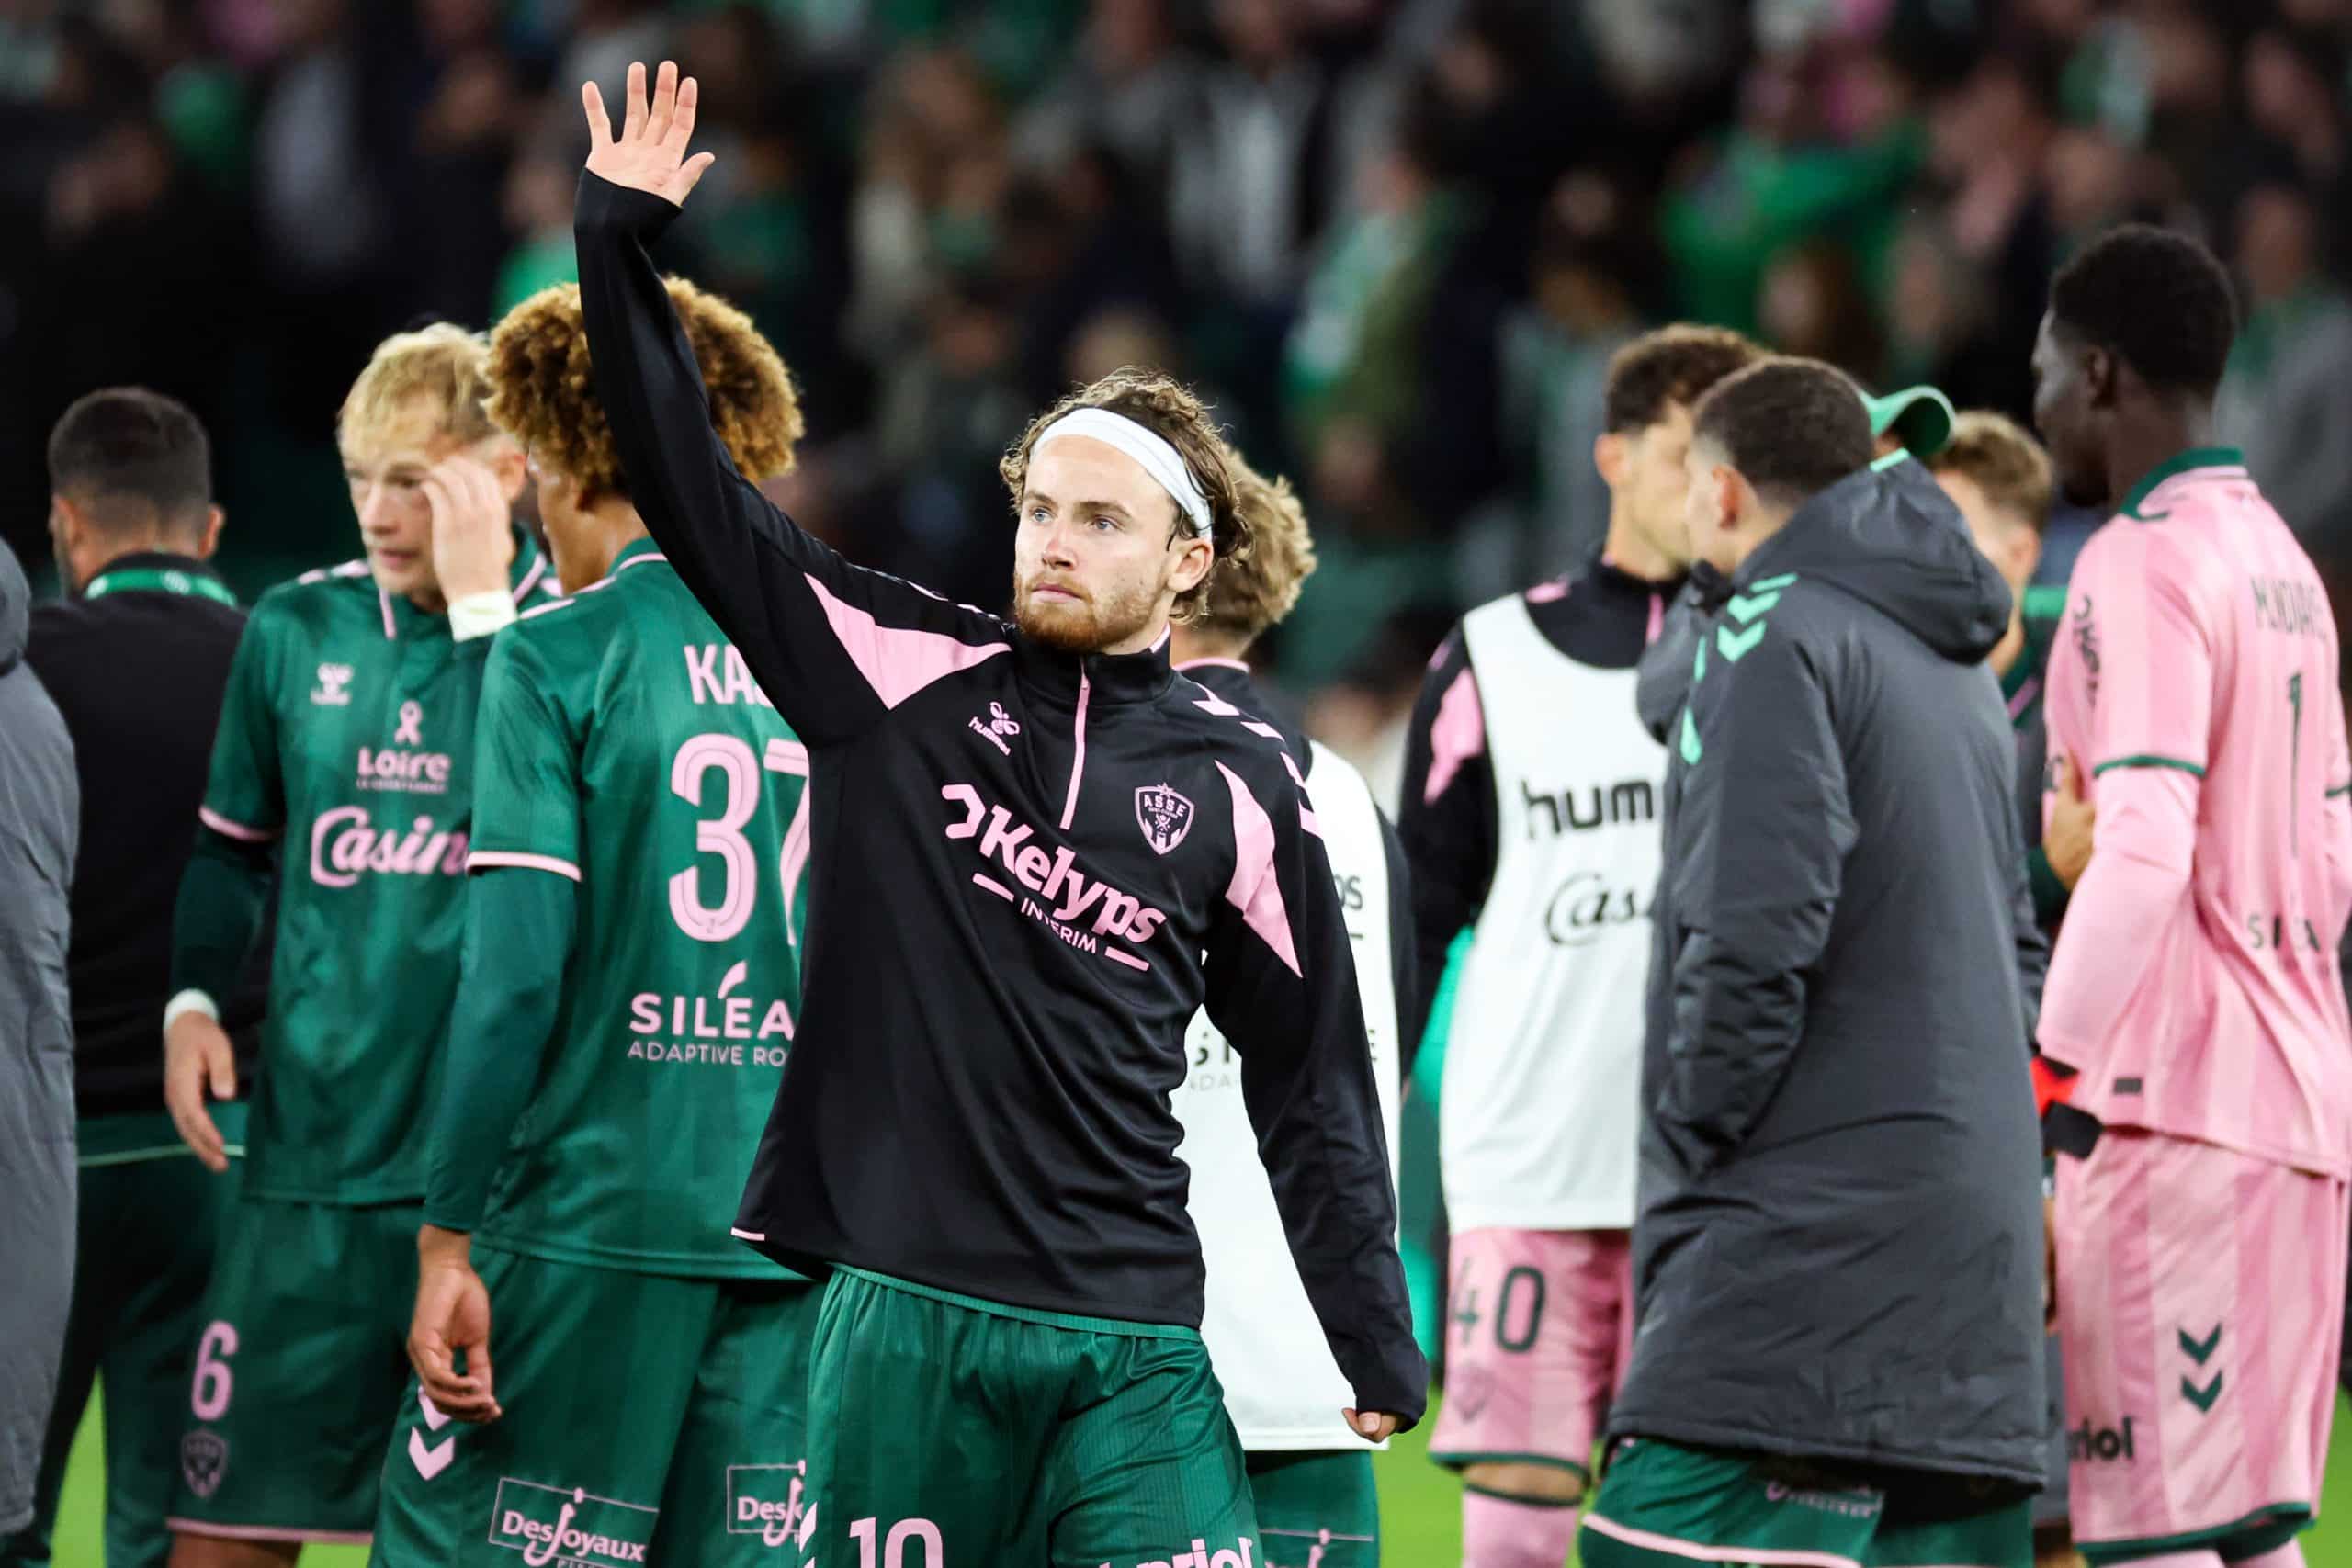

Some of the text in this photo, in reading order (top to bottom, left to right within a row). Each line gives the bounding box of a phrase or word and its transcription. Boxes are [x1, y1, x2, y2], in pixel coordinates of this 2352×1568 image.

[356, 747, 451, 782] Loire
[979, 805, 1167, 943] Kelyps
[628, 1041, 744, 1066] ADAPTIVE
[191, 1319, 238, 1422] 6
